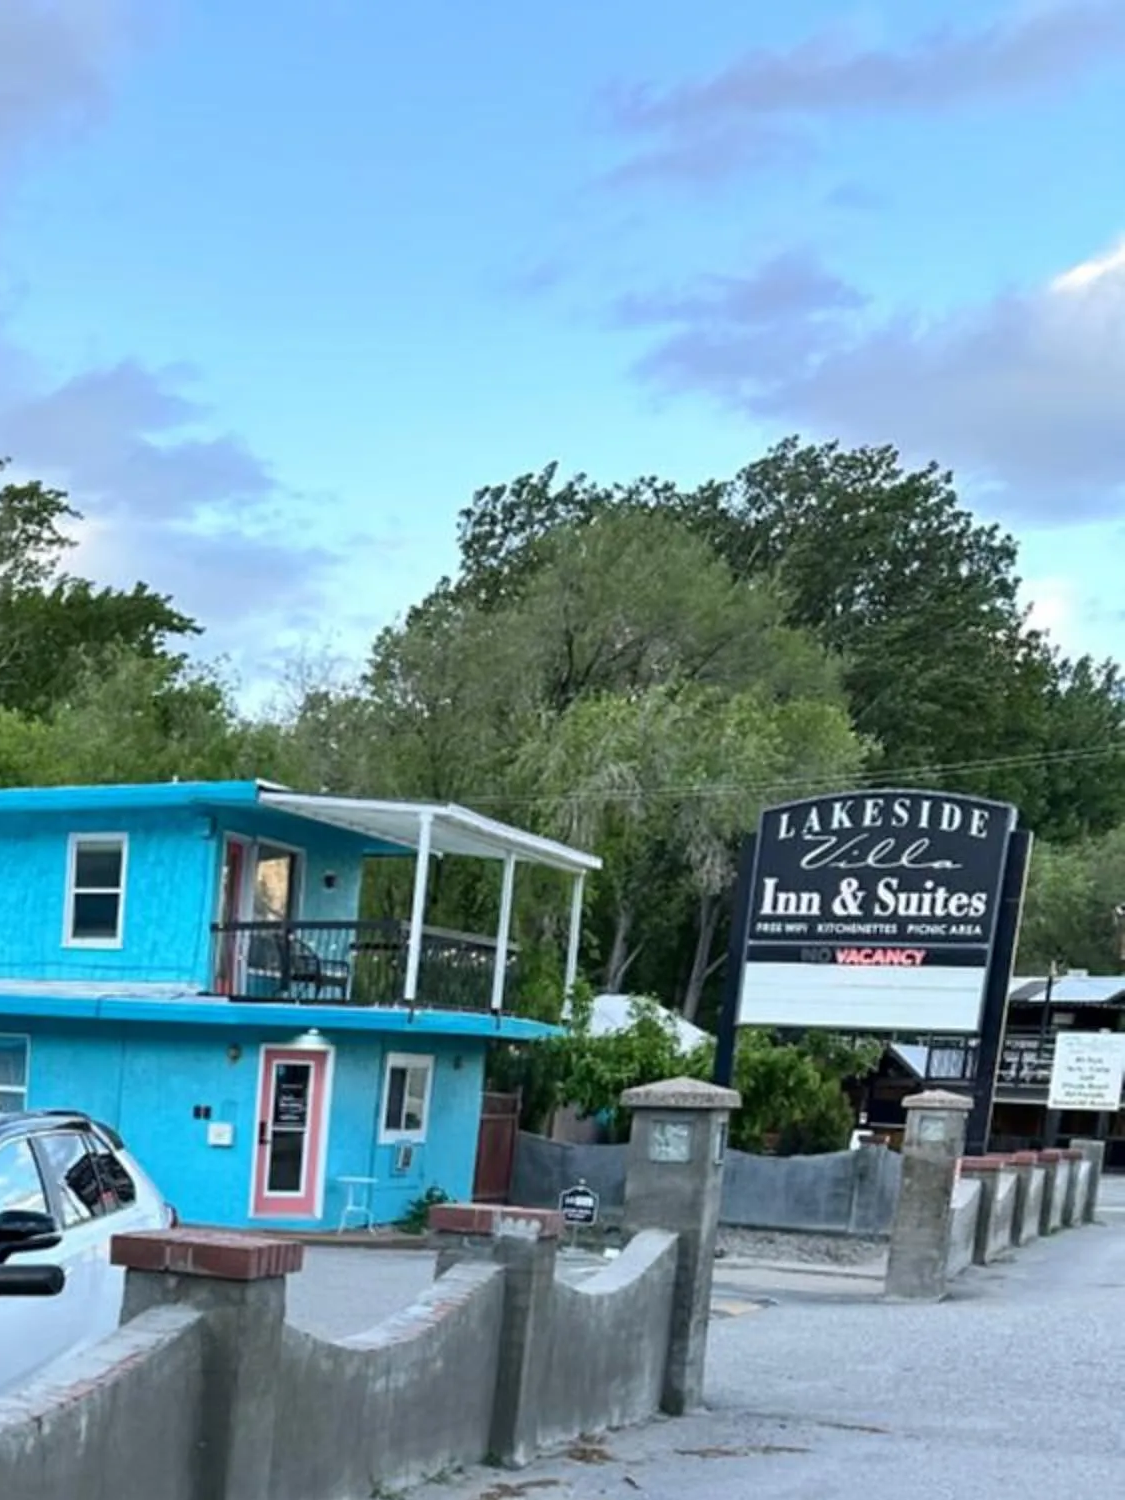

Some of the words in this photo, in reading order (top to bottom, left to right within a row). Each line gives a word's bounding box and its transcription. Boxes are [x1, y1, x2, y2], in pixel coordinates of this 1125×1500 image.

[778, 798, 989, 839] LAKESIDE
[800, 833, 962, 869] Villa
[760, 877, 821, 915] Inn
[832, 877, 866, 916] &
[874, 877, 987, 917] Suites
[755, 922, 782, 933] FREE
[816, 923, 897, 935] KITCHENETTES
[907, 924, 946, 936] PICNIC
[949, 925, 982, 936] AREA
[835, 948, 927, 965] VACANCY
